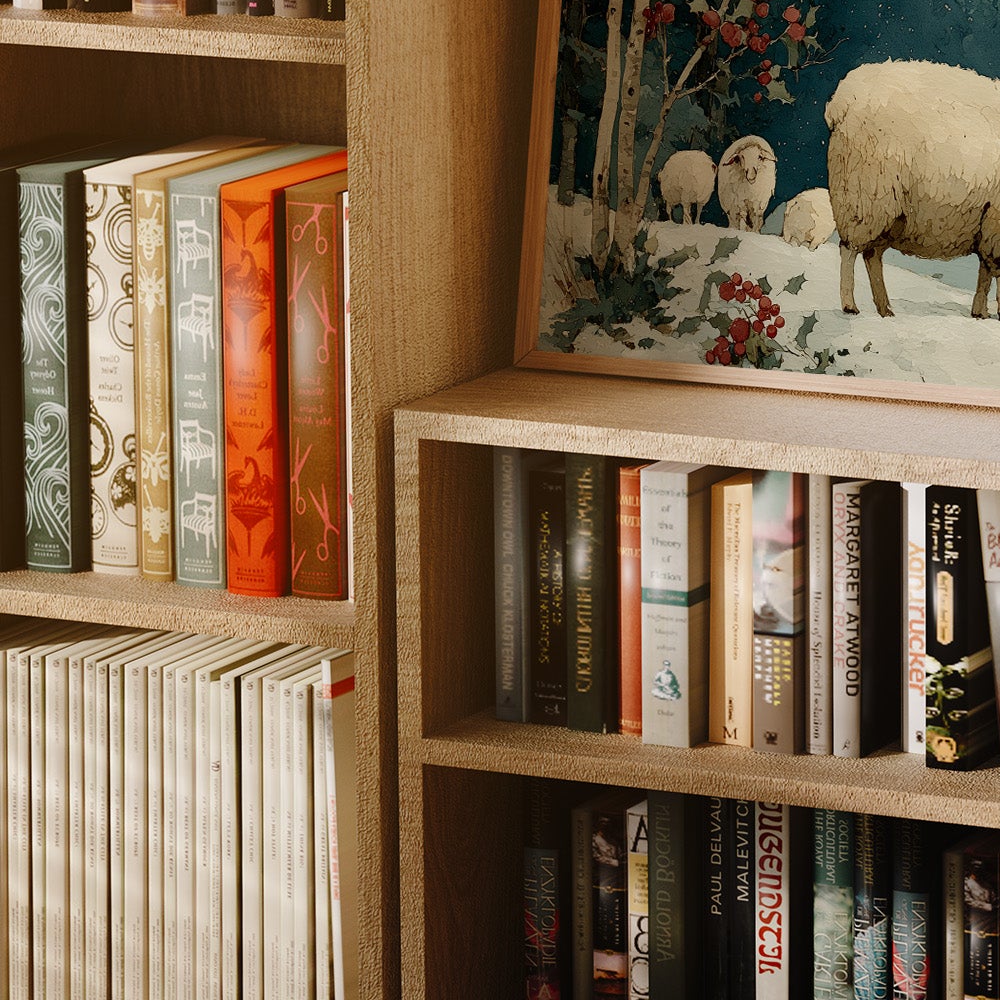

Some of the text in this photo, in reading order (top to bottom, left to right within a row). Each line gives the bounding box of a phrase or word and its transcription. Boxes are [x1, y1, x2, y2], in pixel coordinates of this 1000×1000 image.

[502, 455, 513, 557] DOWNTOWN OWL
[658, 521, 674, 530] the
[661, 504, 672, 513] of
[651, 538, 682, 549] Theory
[944, 504, 962, 565] Shriek:
[650, 571, 682, 581] Fiction
[834, 492, 846, 669] ORYX AND CRAKE
[846, 493, 860, 696] MARGARET ATWOOD
[502, 564, 513, 690] CHUCK KLOSTERMAN
[723, 726, 737, 740] M
[711, 872, 722, 915] PAUL
